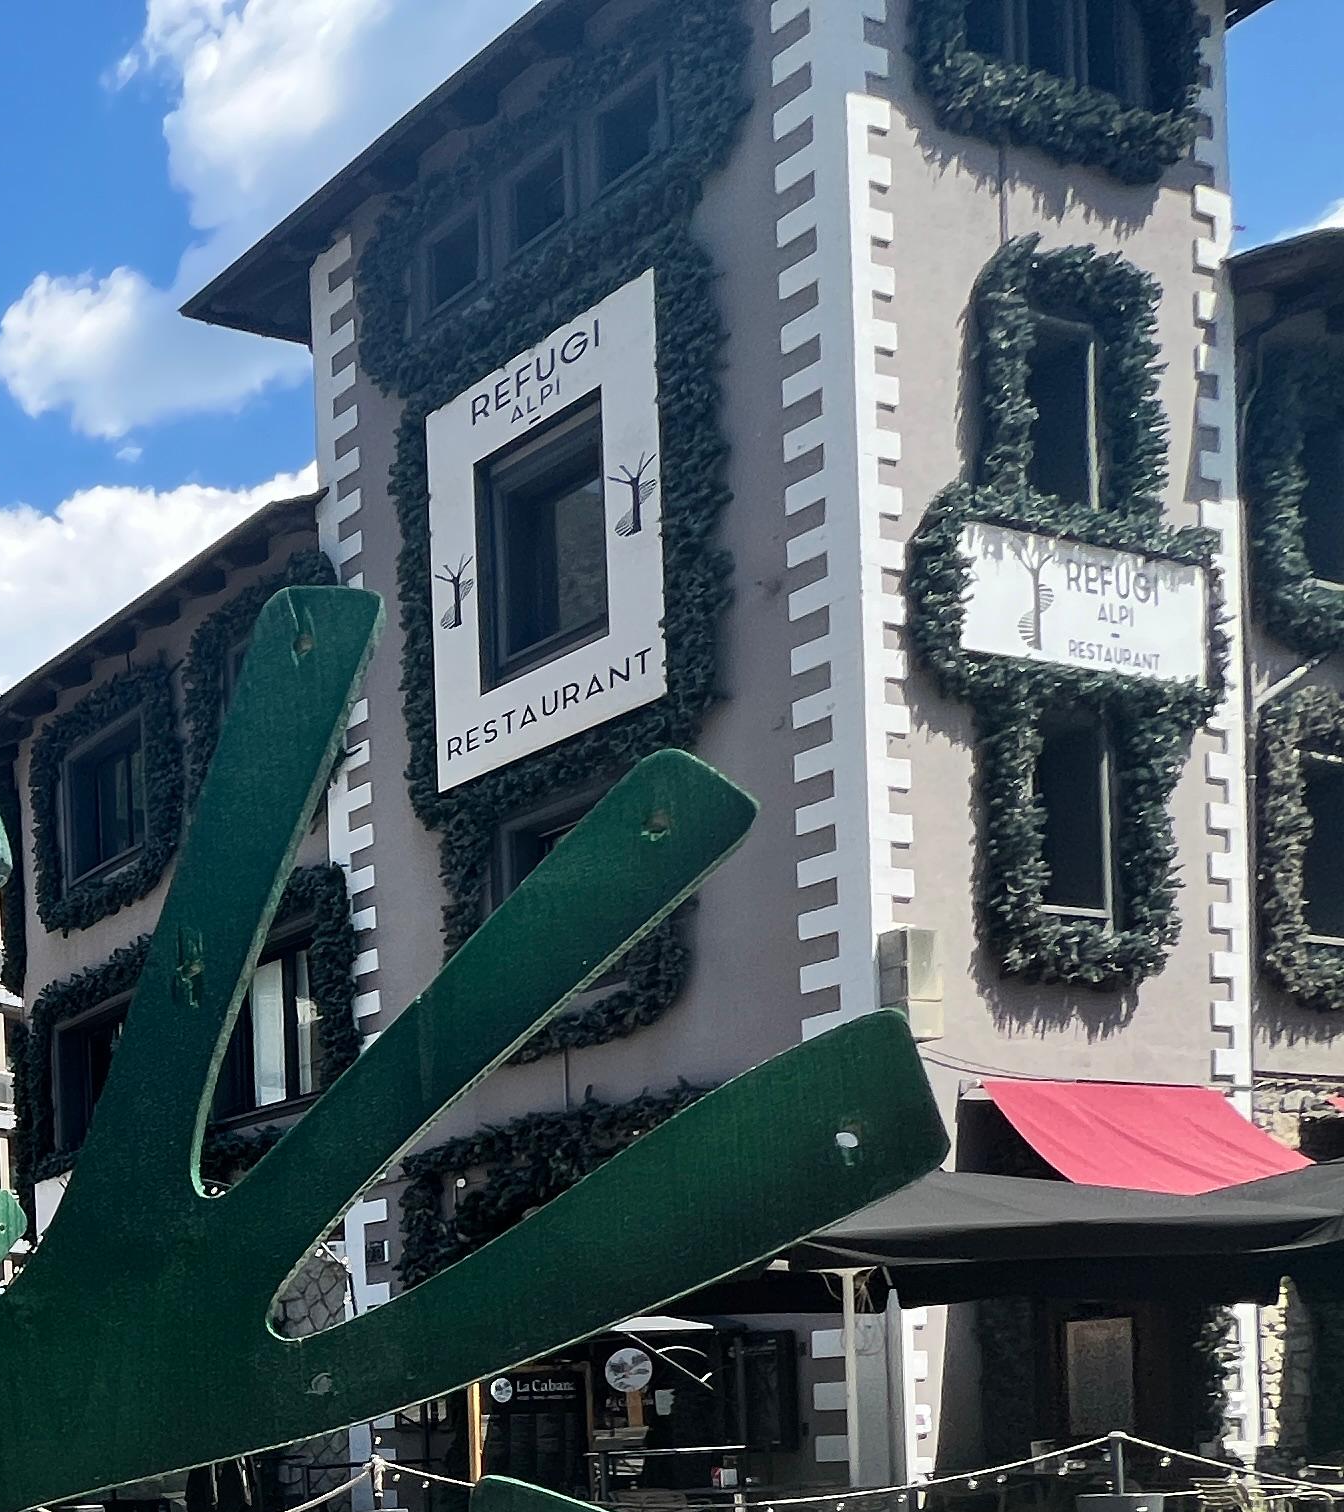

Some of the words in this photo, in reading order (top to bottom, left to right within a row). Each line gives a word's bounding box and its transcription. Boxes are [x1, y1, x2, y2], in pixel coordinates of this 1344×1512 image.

[471, 318, 600, 425] REFUGI
[511, 377, 560, 424] ALPI
[1066, 559, 1159, 606] REFUGI
[1097, 602, 1134, 627] ALPI
[1068, 639, 1160, 671] RESTAURANT
[447, 647, 652, 761] RESTAURANT
[516, 1379, 530, 1392] La
